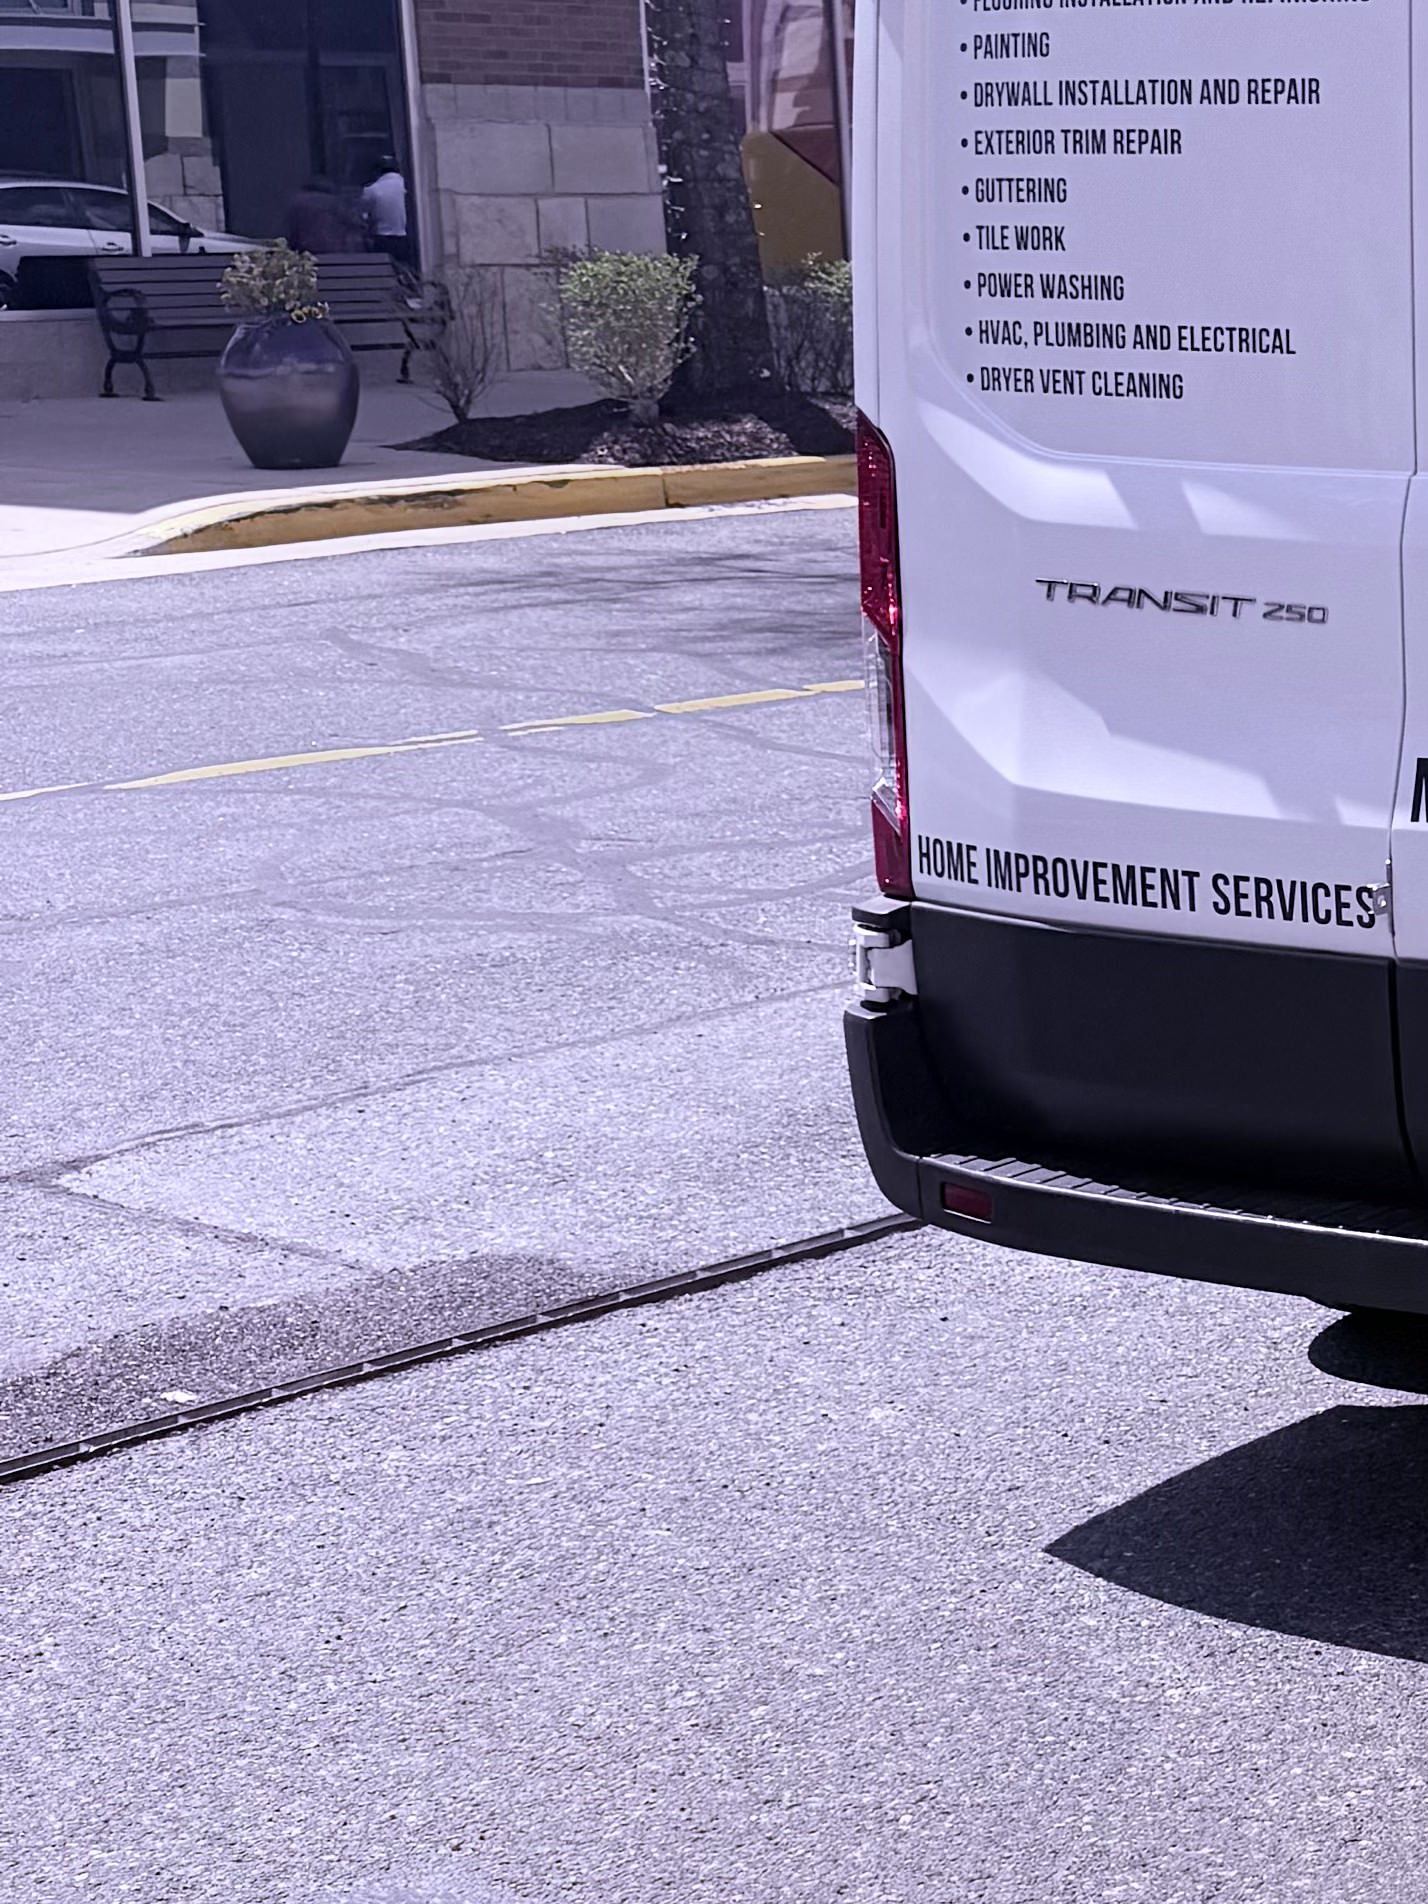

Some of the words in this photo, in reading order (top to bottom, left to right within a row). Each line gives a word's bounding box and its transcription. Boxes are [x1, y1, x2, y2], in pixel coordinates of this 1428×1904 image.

[973, 31, 1050, 59] PAINTING
[973, 80, 1053, 107] DRYWALL
[1058, 78, 1192, 105] INSTALLATION
[1199, 78, 1239, 104] AND
[1247, 77, 1320, 104] REPAIR
[974, 129, 1055, 155] EXTERIOR
[1060, 128, 1106, 154] TRIM
[1113, 128, 1182, 154] REPAIR
[974, 177, 1067, 203] GUTTERING
[975, 224, 1009, 250] TILE
[1014, 225, 1066, 251] WORK
[976, 272, 1034, 298] POWER
[1039, 273, 1125, 300] WASHING
[978, 319, 1028, 349] HVAC,
[1033, 320, 1126, 349] PLUMBING
[1132, 323, 1170, 350] AND
[1177, 325, 1297, 354] ELECTRICAL
[980, 366, 1034, 393] DRYER
[1039, 368, 1085, 395] VENT
[1091, 370, 1184, 399] CLEANING
[1035, 578, 1256, 618] TRANSIT
[1262, 602, 1329, 624] 250
[917, 835, 980, 884] HOME
[985, 848, 1200, 912] IMPROVEMENT
[1212, 873, 1376, 929] SERVICES
